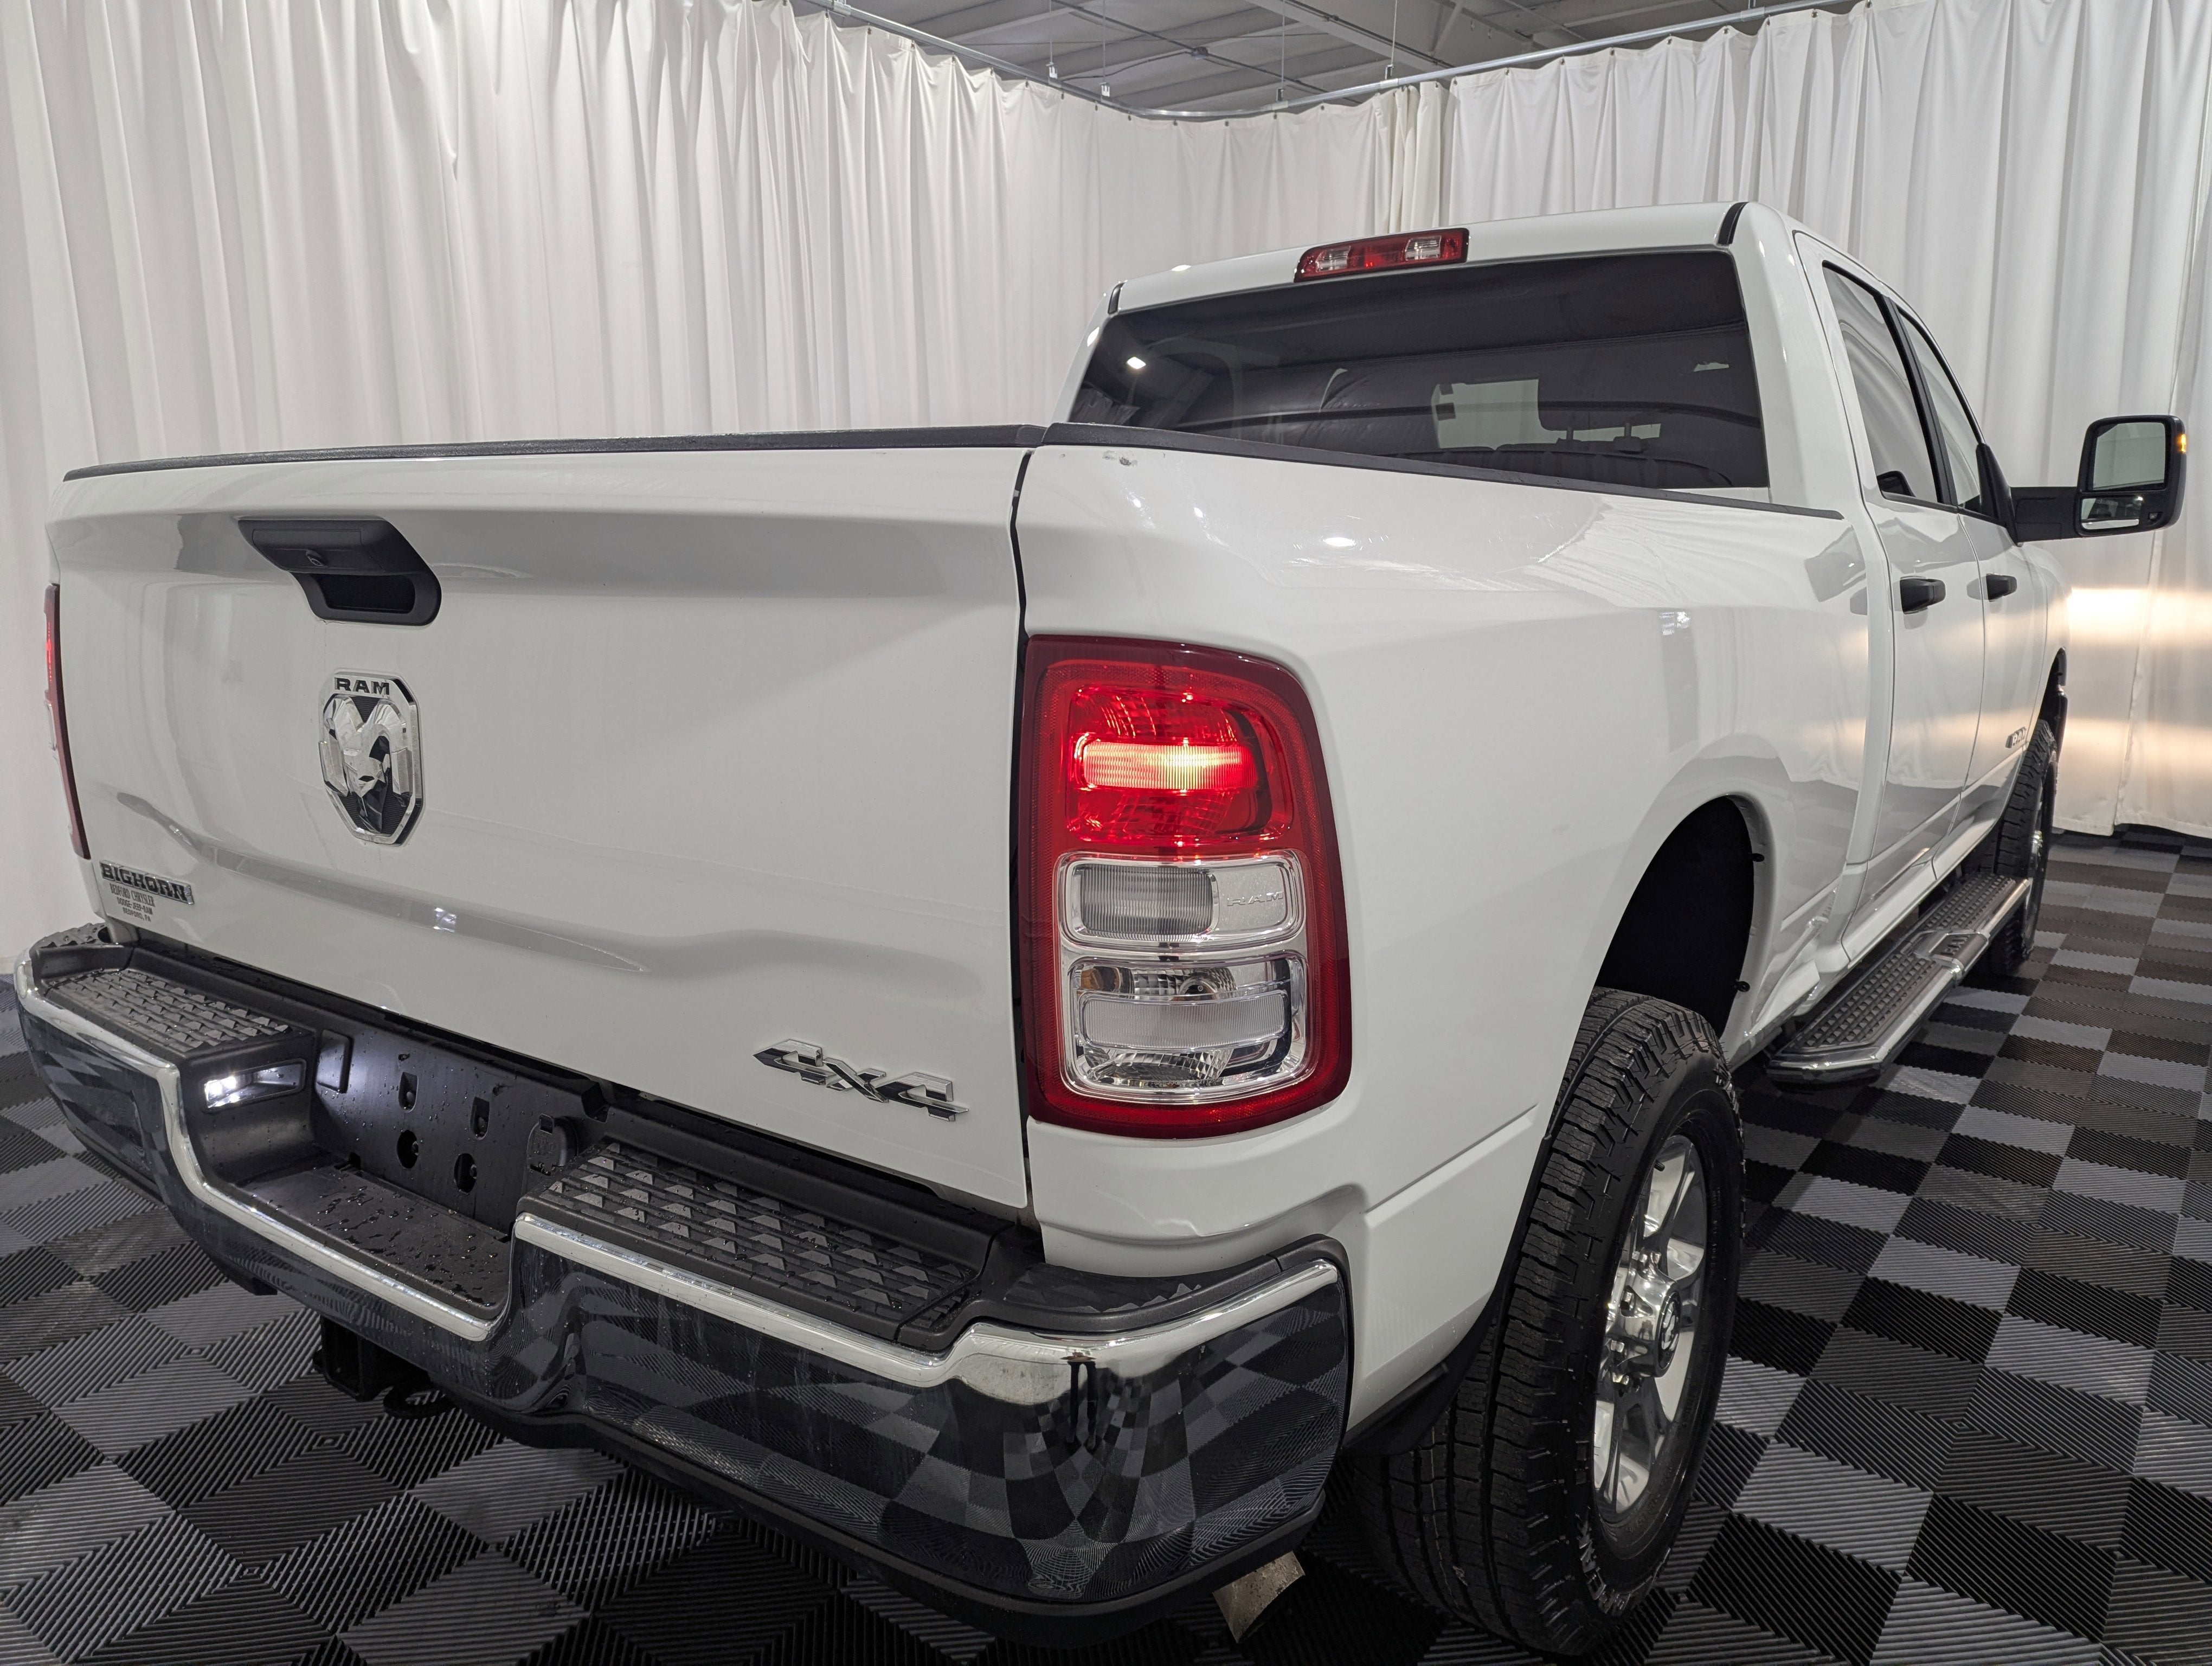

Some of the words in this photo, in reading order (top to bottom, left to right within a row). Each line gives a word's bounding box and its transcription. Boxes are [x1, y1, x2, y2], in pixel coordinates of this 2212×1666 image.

[335, 677, 390, 695] RAM
[100, 860, 194, 905] BIGHORN
[110, 883, 131, 899] BEDFORD
[131, 890, 156, 907] CHRYSLER
[1227, 890, 1284, 907] RAM
